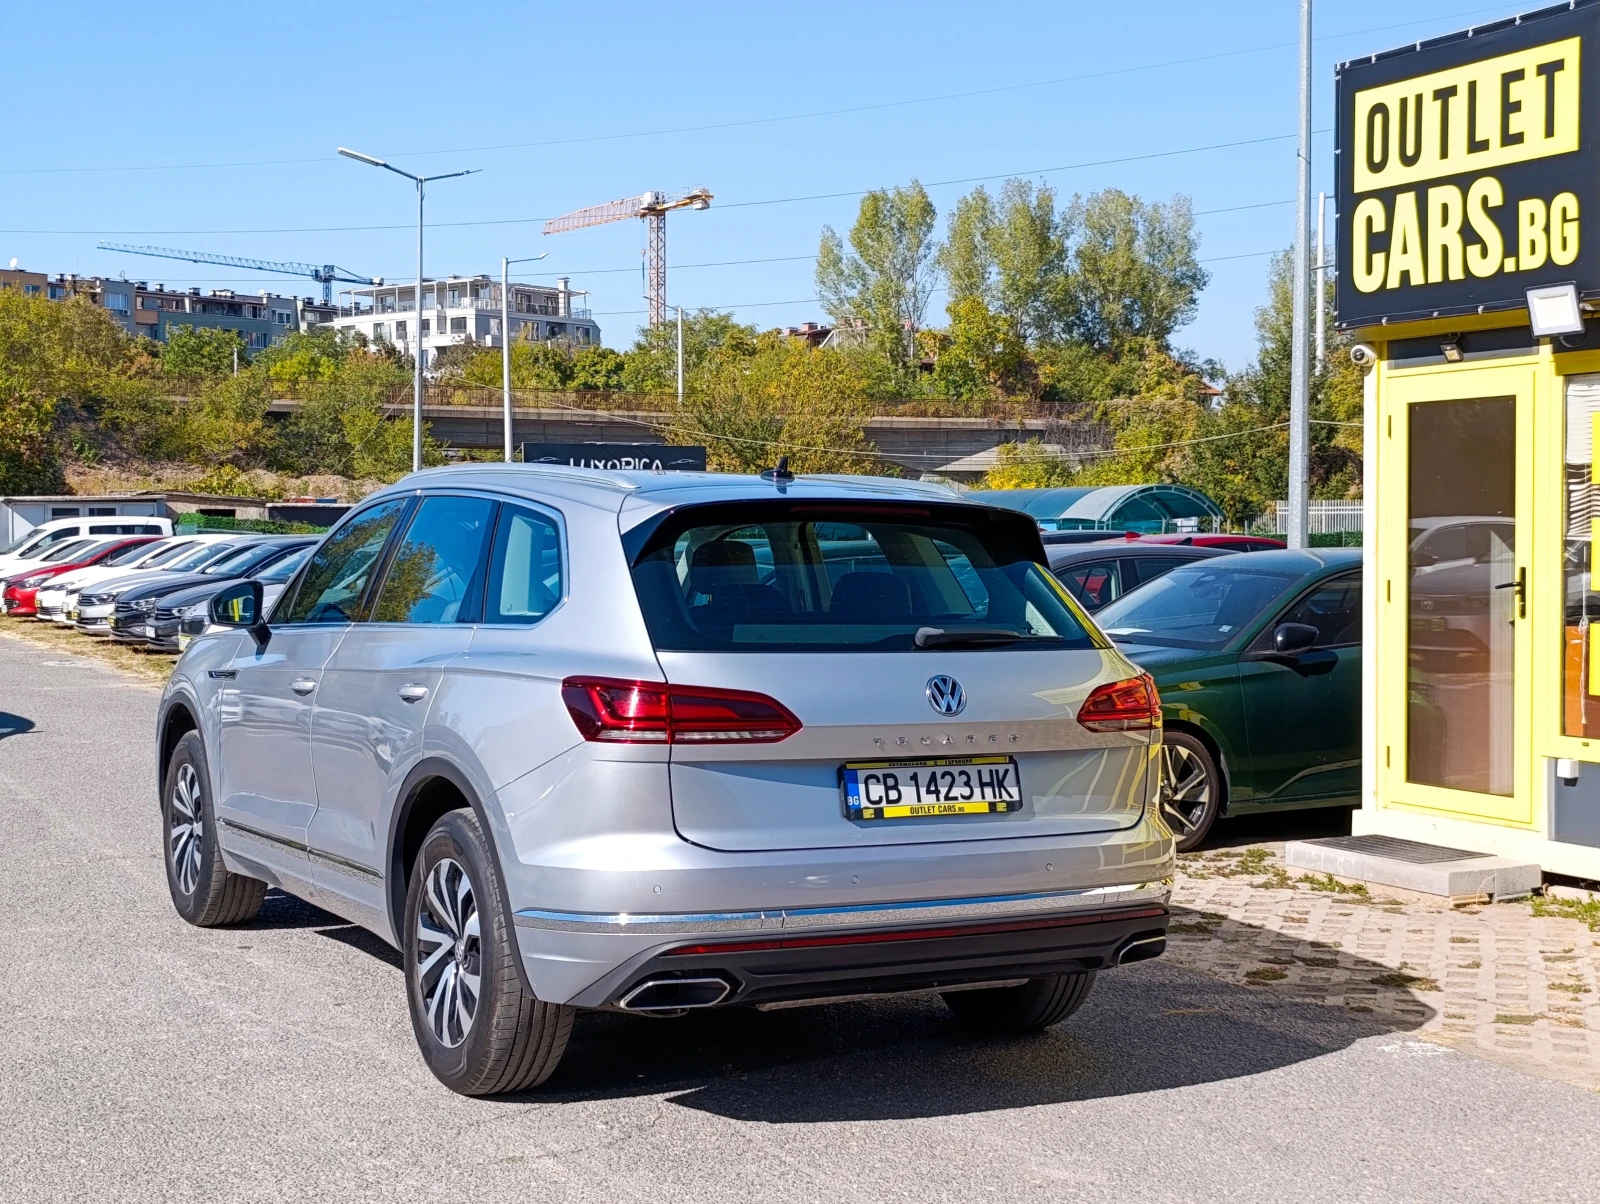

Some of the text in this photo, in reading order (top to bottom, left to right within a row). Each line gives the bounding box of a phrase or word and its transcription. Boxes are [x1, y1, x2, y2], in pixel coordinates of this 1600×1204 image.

[1365, 58, 1566, 175] OUTLET
[1352, 176, 1580, 293] CARS.BG
[873, 733, 1019, 746] TOUAREG
[863, 768, 1014, 806] CB 1423 HK
[847, 795, 860, 806] BG
[909, 805, 936, 815] OUTLET
